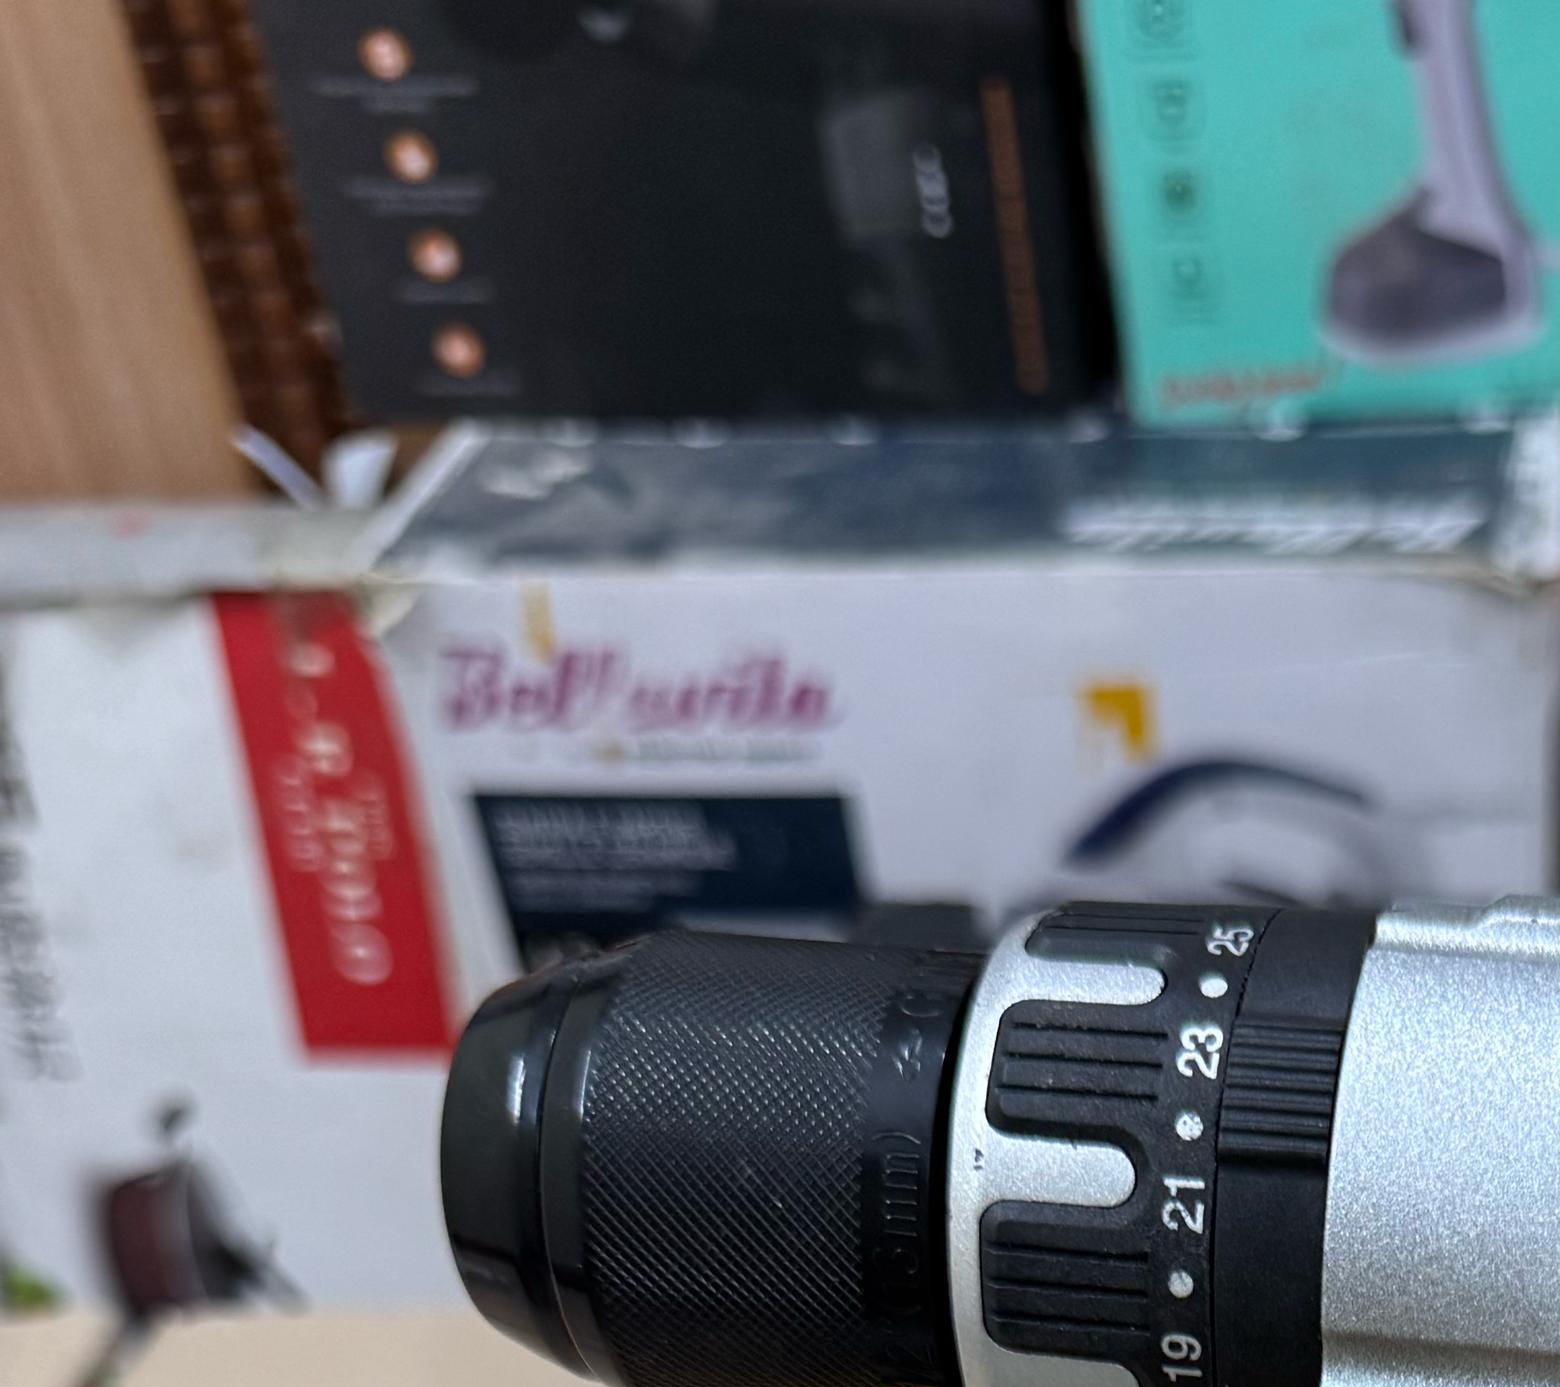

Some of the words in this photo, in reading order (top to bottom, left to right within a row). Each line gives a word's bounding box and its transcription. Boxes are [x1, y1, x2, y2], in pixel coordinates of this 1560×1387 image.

[1206, 925, 1255, 957] 25
[1176, 1024, 1224, 1080] 23
[1161, 1176, 1206, 1235] 21
[1161, 1333, 1203, 1383] 19
